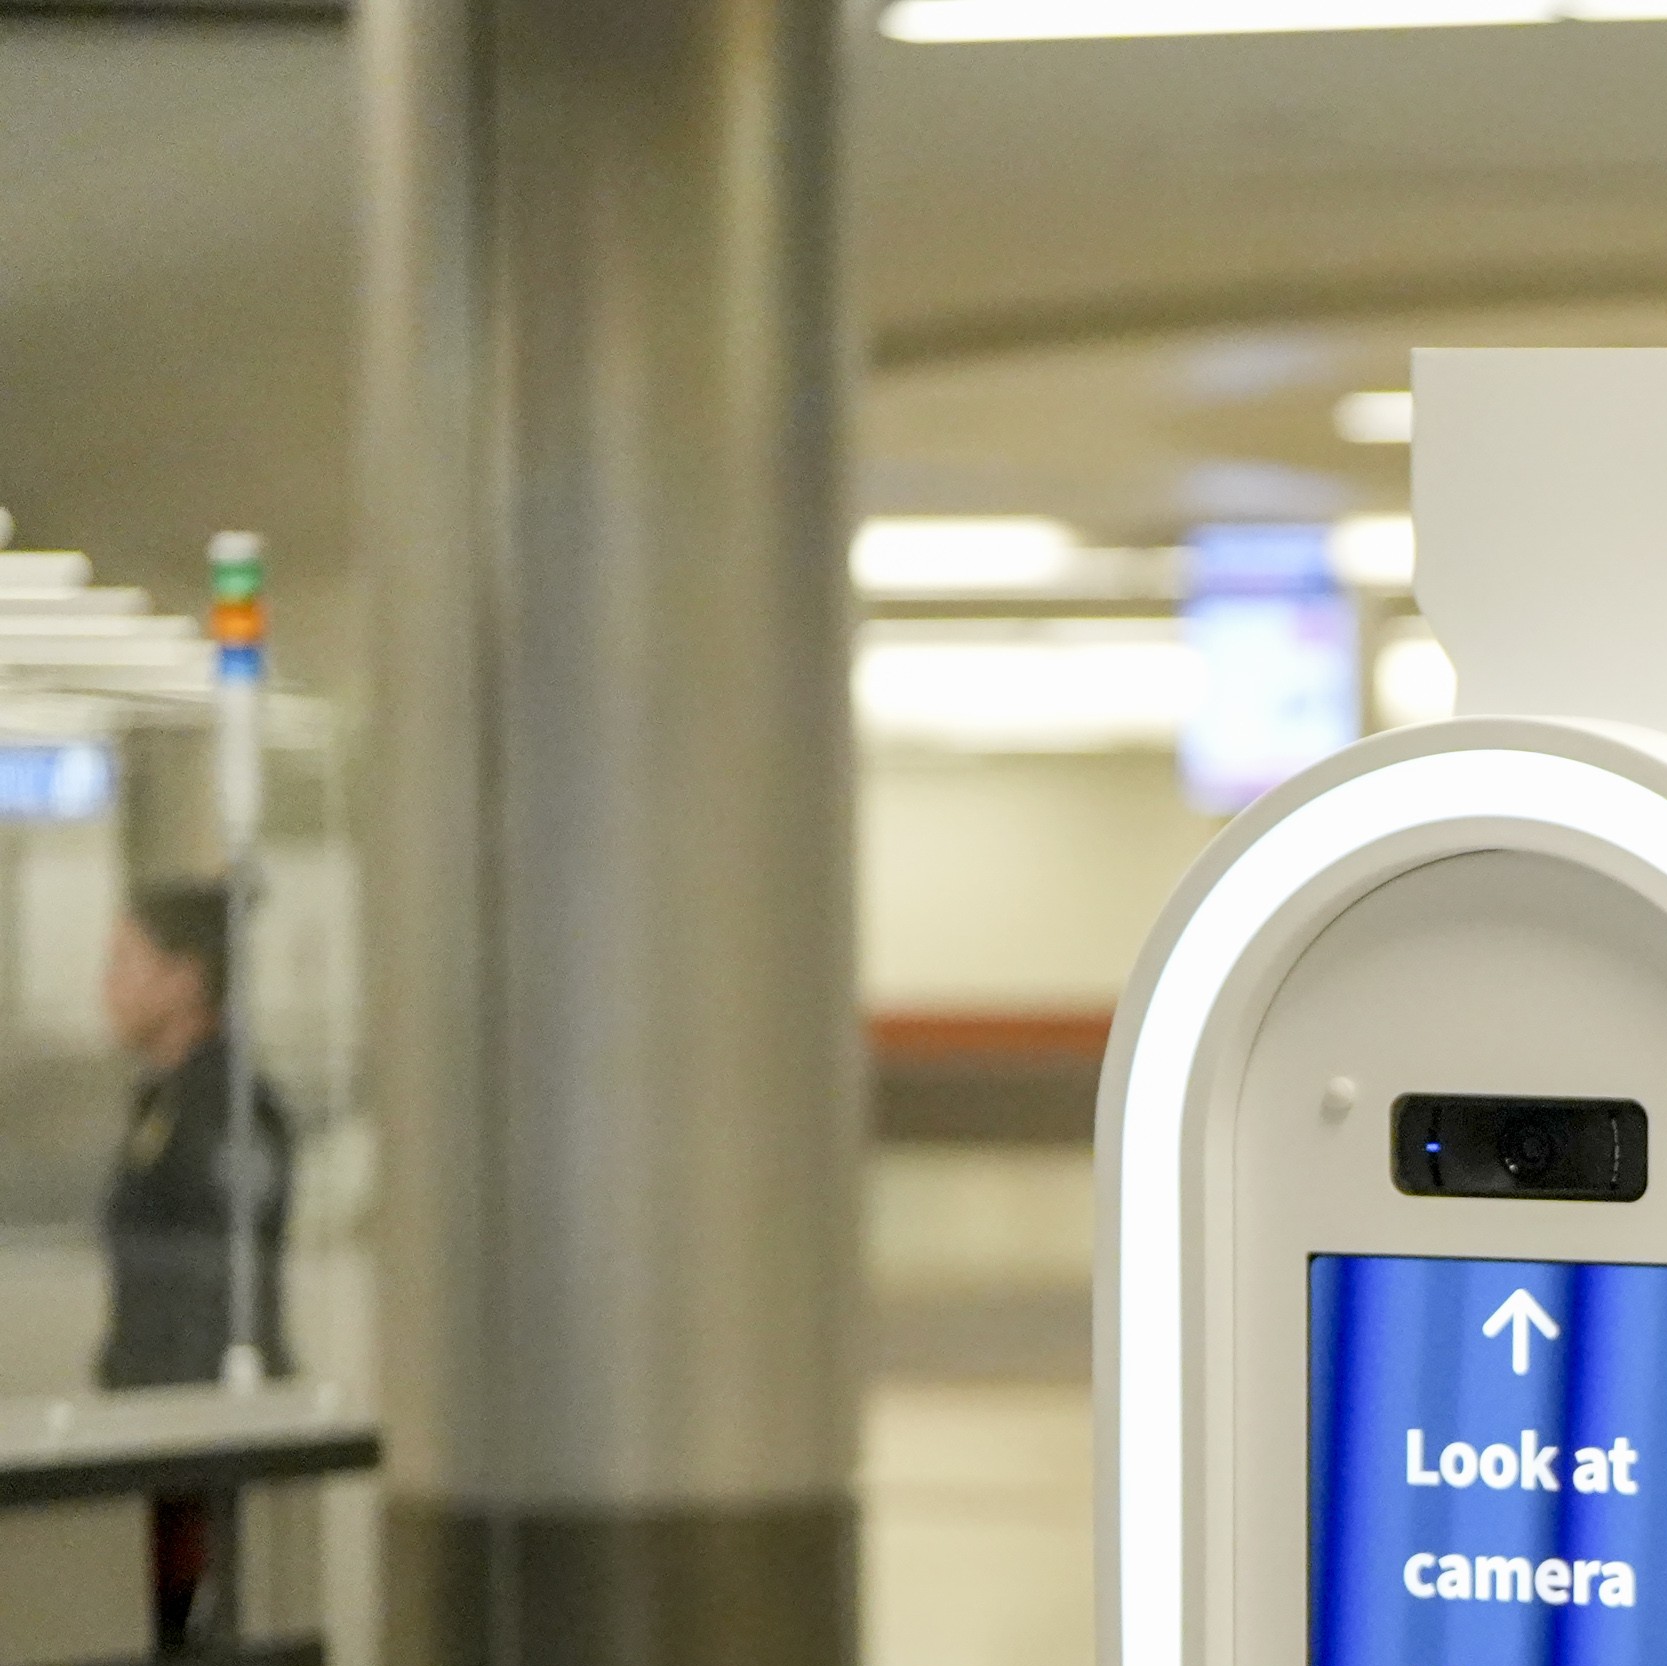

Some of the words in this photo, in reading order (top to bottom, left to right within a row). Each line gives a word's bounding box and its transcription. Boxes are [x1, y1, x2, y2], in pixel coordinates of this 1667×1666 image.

[1406, 1428, 1561, 1492] Look
[1572, 1437, 1639, 1495] at
[1403, 1552, 1637, 1608] camera
